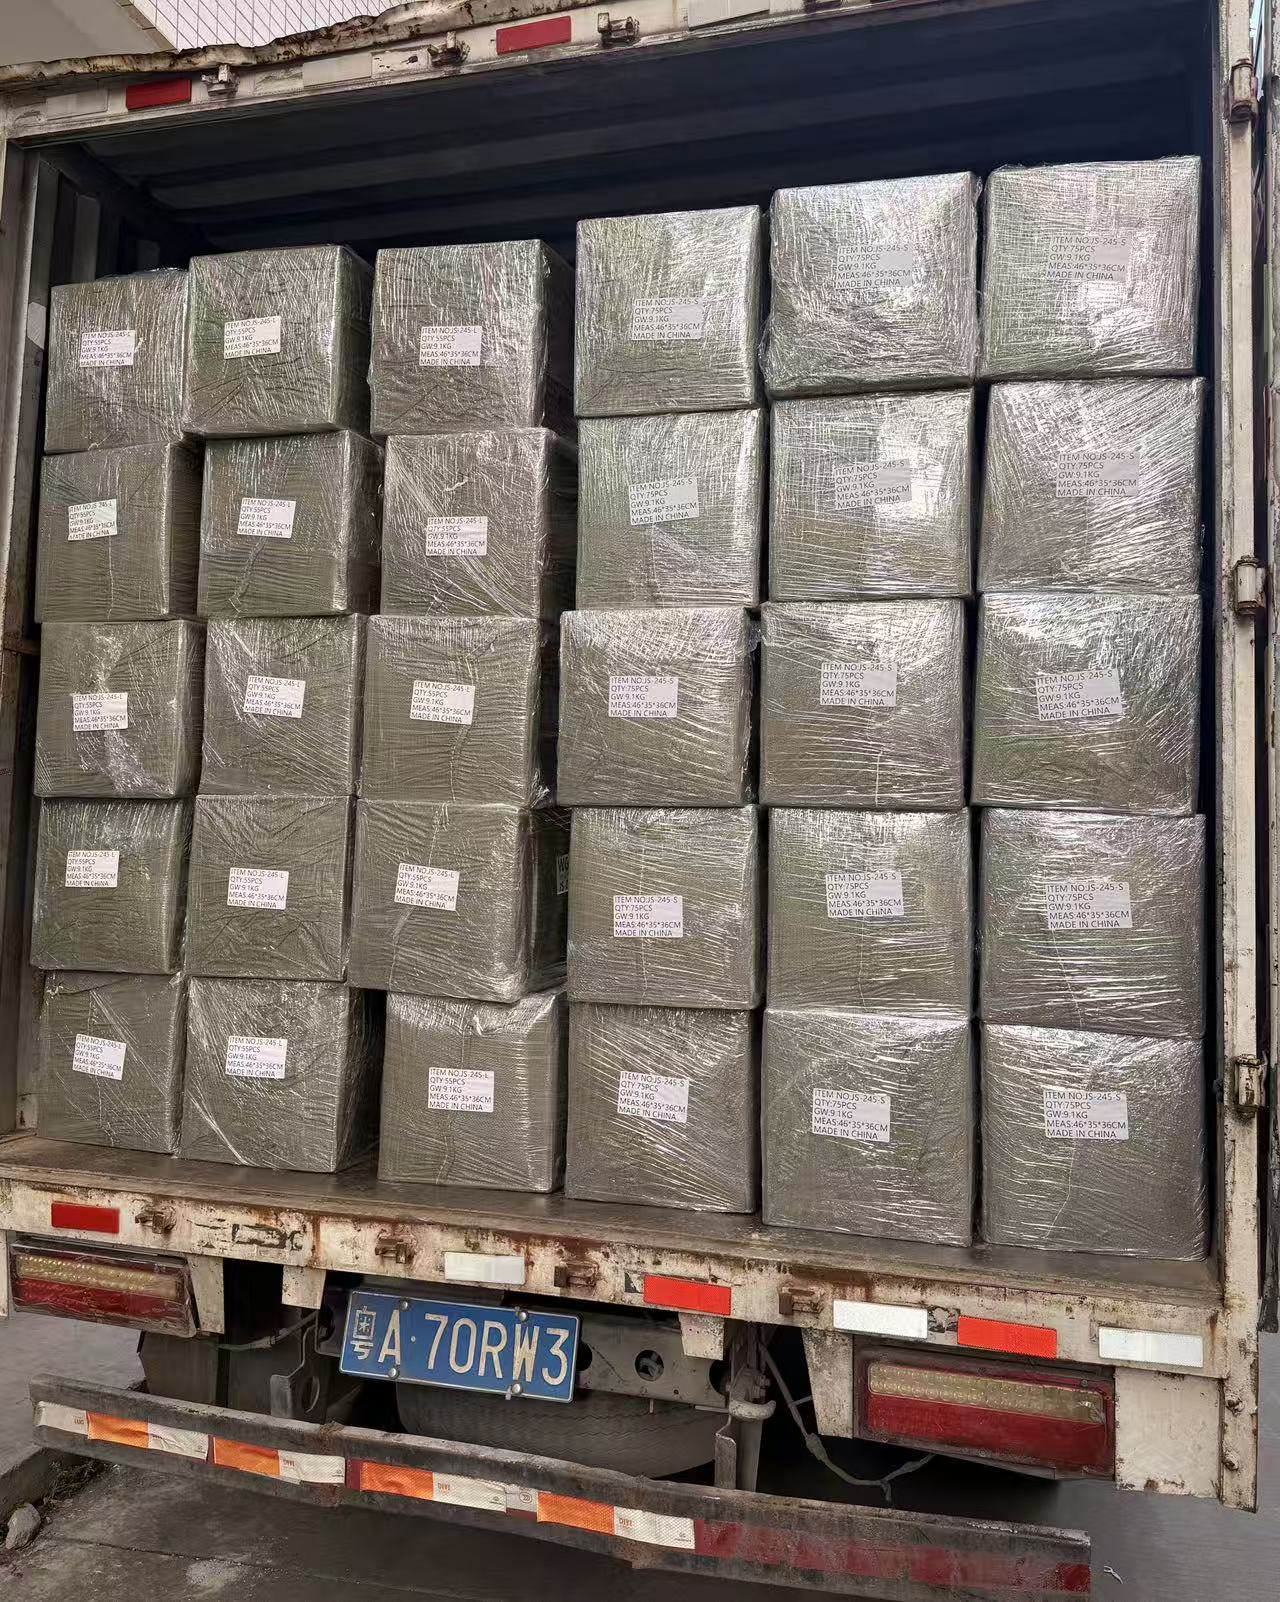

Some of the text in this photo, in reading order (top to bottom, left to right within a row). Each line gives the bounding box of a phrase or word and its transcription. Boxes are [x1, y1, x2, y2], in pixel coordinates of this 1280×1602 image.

[635, 307, 673, 315] QTY:75PCS
[630, 484, 647, 492] ITEM
[630, 489, 668, 501] QTY:75PCS
[632, 516, 653, 524] MADE
[665, 511, 689, 520] CHINA
[823, 672, 864, 680] QTY:75PCS
[1037, 676, 1058, 685] ITEM
[1038, 682, 1084, 694] QTY:75PCS
[1040, 711, 1067, 720] MADE
[1081, 706, 1110, 716] CHINA
[828, 882, 869, 891] QTY:75PCS
[396, 896, 415, 904] MADE
[424, 900, 446, 909] CHINA
[1048, 893, 1094, 902] QTY:75PCS
[622, 1072, 639, 1081] ITEM
[621, 1080, 659, 1093] QTY:75PCS
[815, 1089, 834, 1098] ITEM
[814, 1098, 857, 1111] QTY:75PCS
[1045, 1101, 1091, 1110] QTY:75PCS
[619, 1106, 640, 1115] MADE
[652, 1111, 677, 1120] CHINA
[814, 1126, 838, 1135] MADE
[851, 1130, 878, 1140] CHINA
